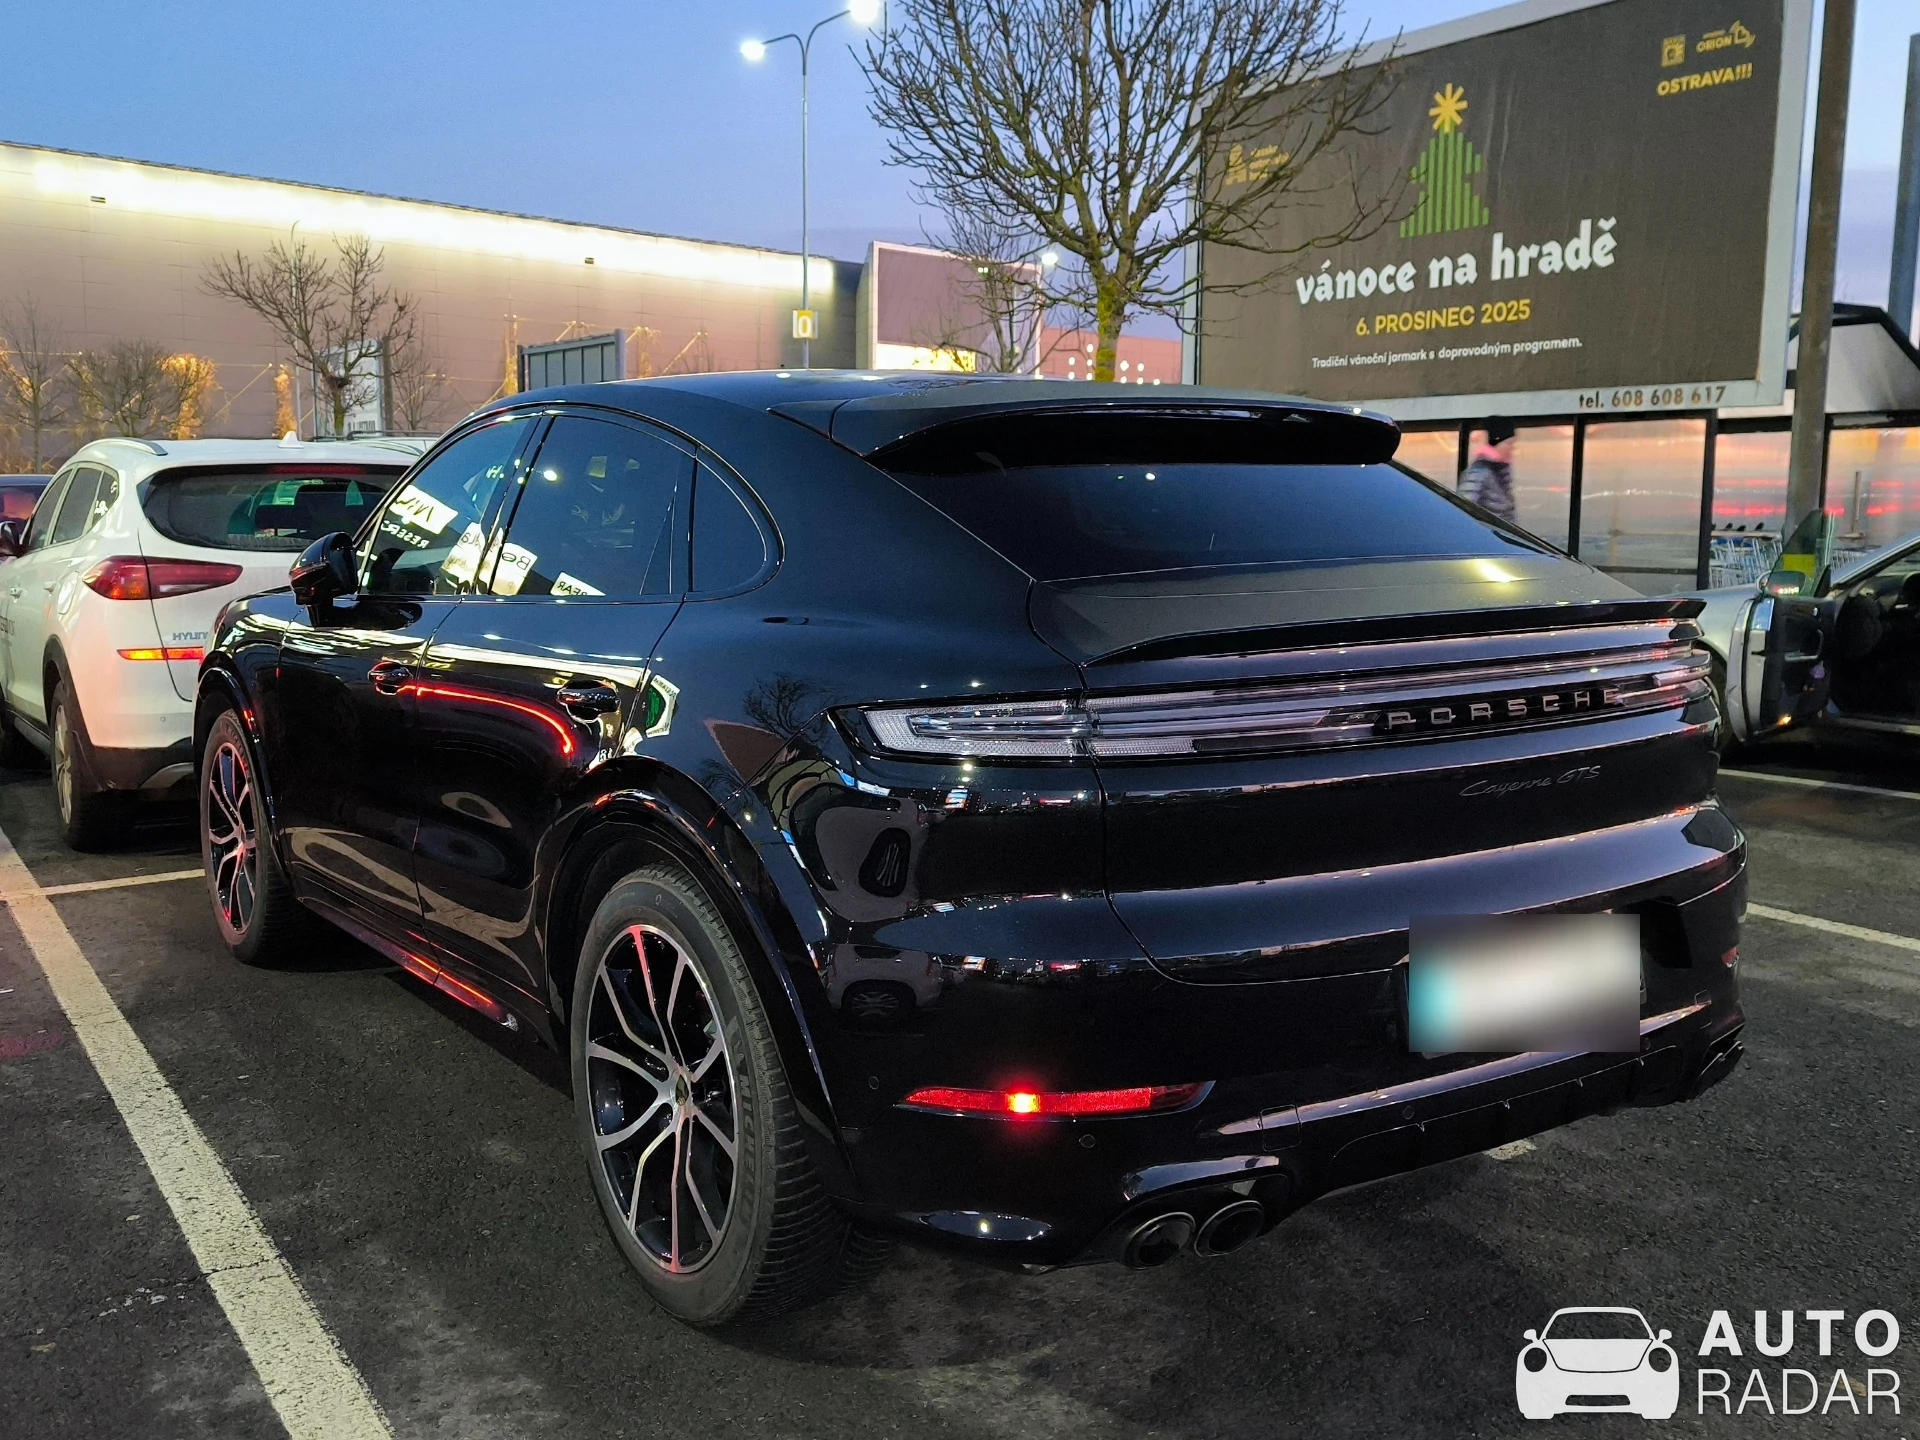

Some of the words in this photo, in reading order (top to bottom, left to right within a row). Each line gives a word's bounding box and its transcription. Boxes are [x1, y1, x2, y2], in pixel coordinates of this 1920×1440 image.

[1657, 62, 1753, 96] OSTRAVA!!!
[1296, 258, 1417, 305] vánoce
[1428, 252, 1478, 289] na
[1491, 216, 1618, 281] hradě
[1356, 317, 1370, 336] 6.
[1375, 304, 1475, 334] PROSINEC
[1481, 298, 1531, 325] 2025
[1312, 355, 1349, 368] Tradiční
[1350, 353, 1387, 365] vánoční
[1387, 348, 1427, 365] jarmark
[1429, 352, 1435, 360] s
[1438, 341, 1511, 361] doprovodným
[1512, 336, 1583, 355] programem.
[1579, 391, 1605, 408] tel.
[1611, 390, 1644, 407] 608
[1650, 387, 1684, 406] 608
[1691, 385, 1727, 404] 617
[1387, 688, 1620, 730] PORSCHE
[1459, 776, 1552, 798] Cayenne
[1557, 765, 1601, 783] GTS
